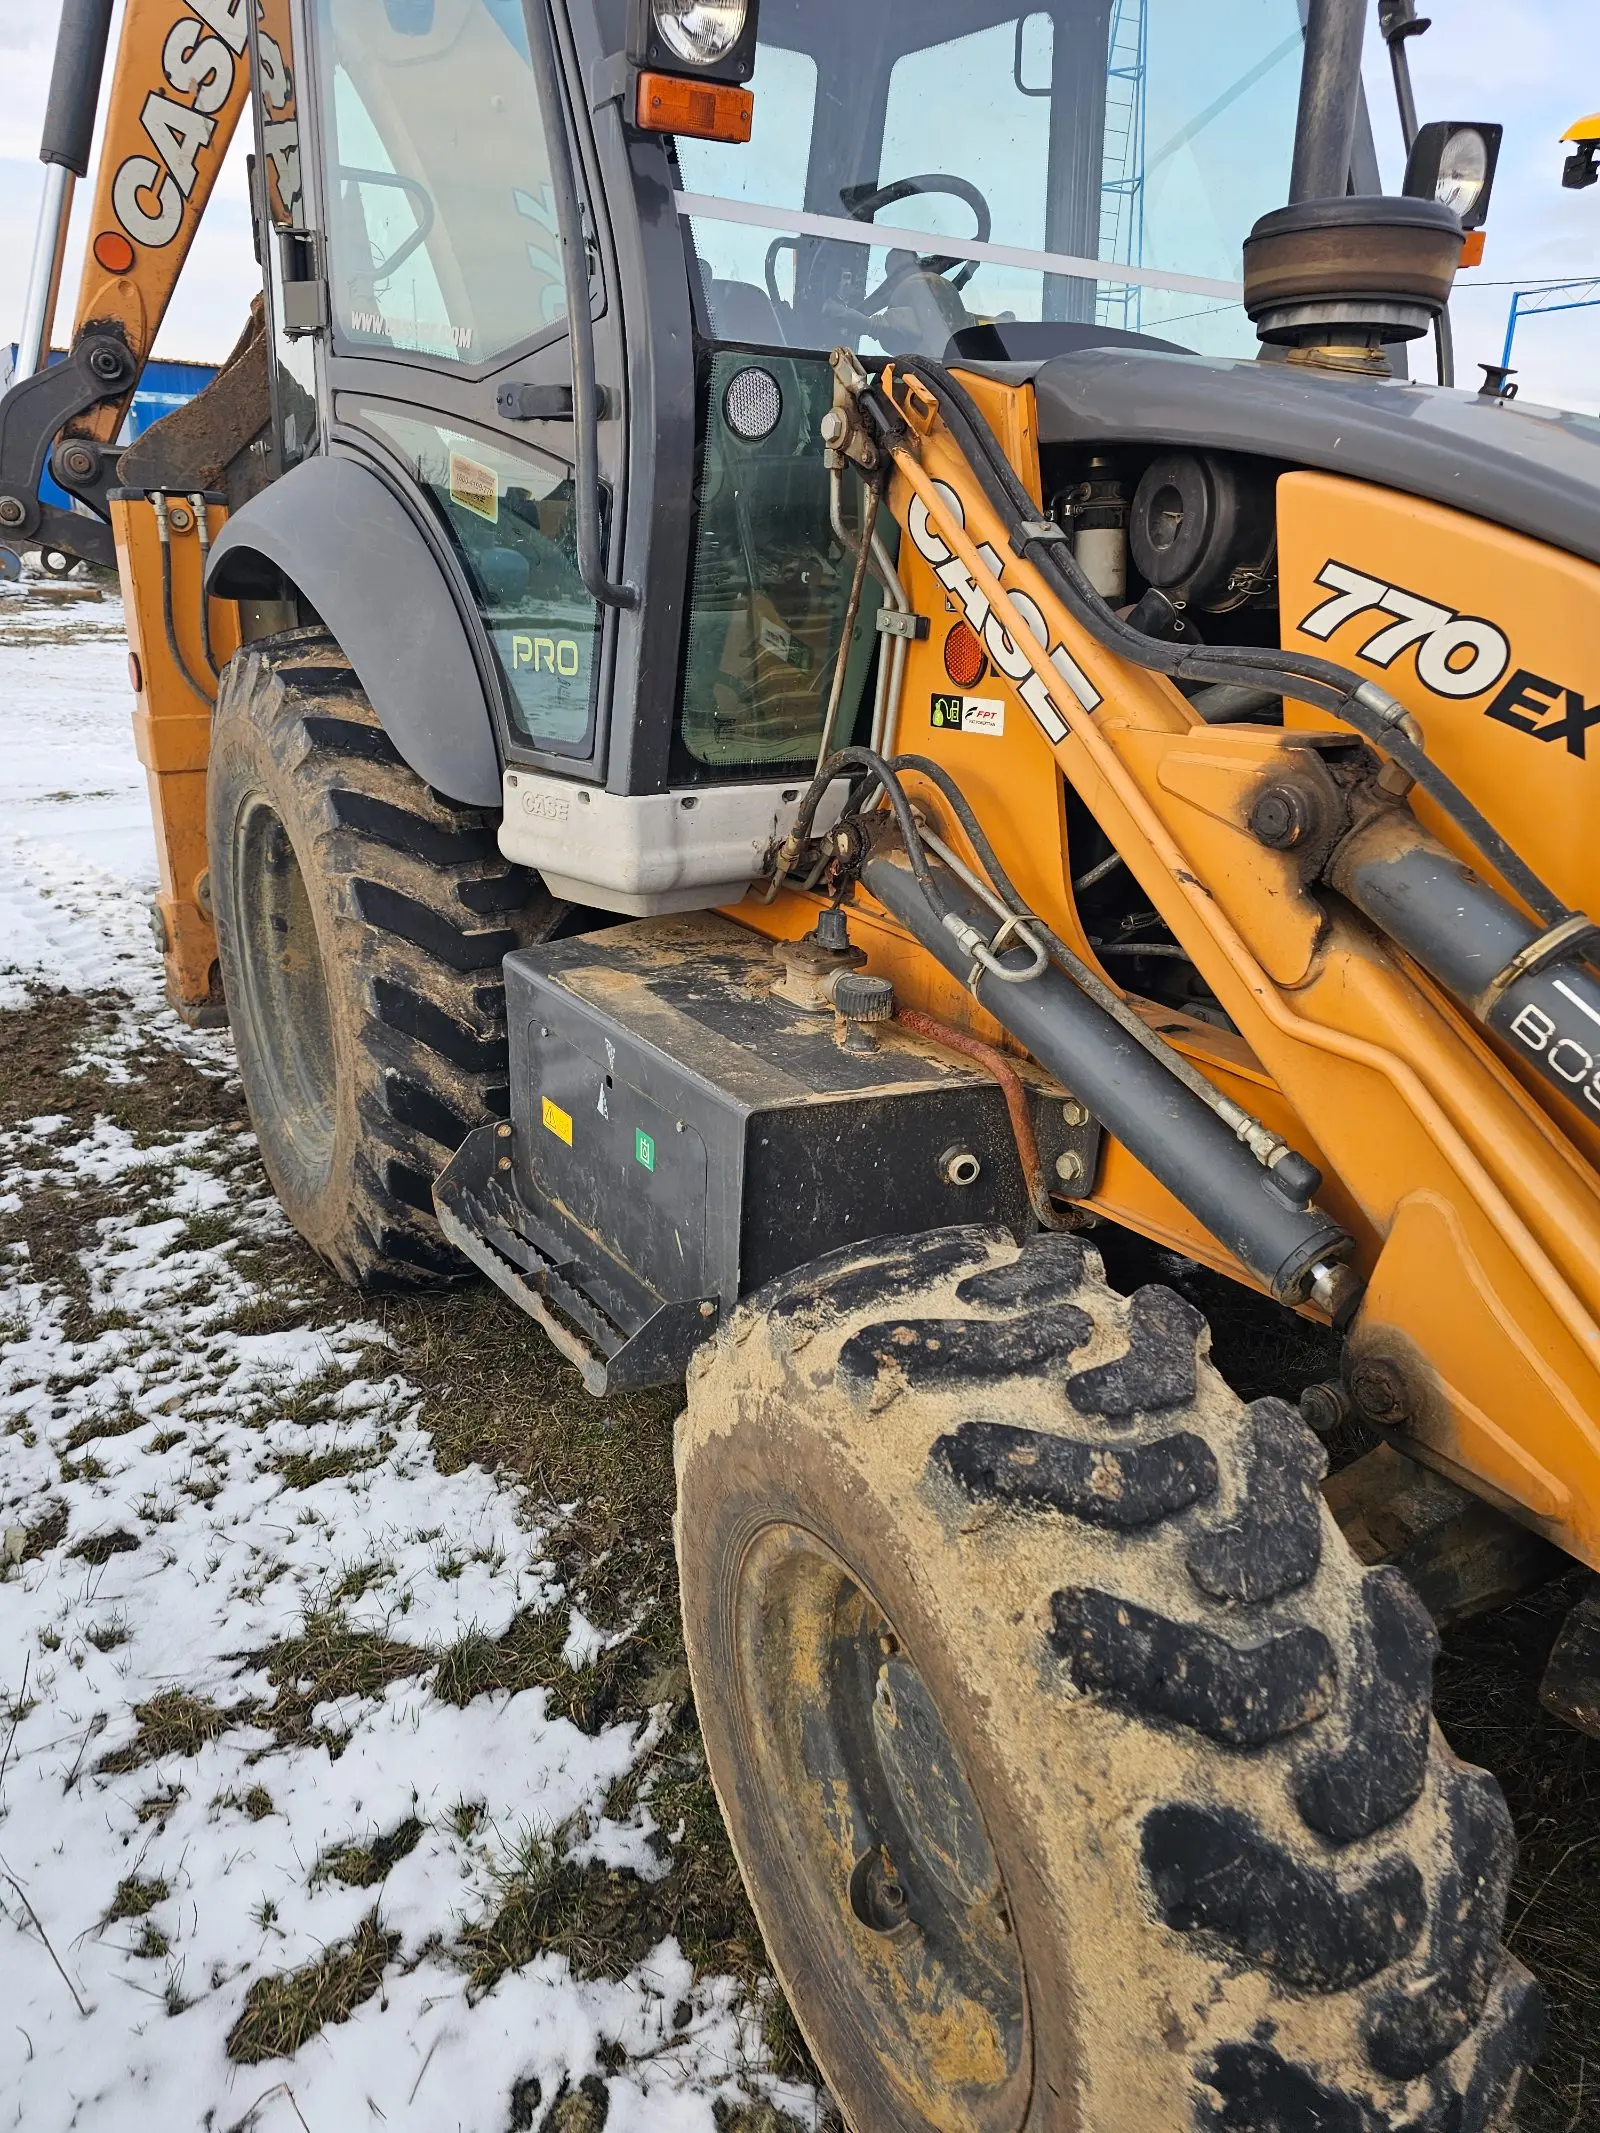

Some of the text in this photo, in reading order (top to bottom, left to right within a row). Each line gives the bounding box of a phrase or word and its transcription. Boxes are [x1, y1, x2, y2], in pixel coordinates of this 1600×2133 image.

[908, 478, 1104, 746] CASE
[513, 636, 579, 676] PRO
[1296, 558, 1600, 761] 770 EX
[976, 710, 998, 720] FPT
[522, 790, 570, 821] CASE
